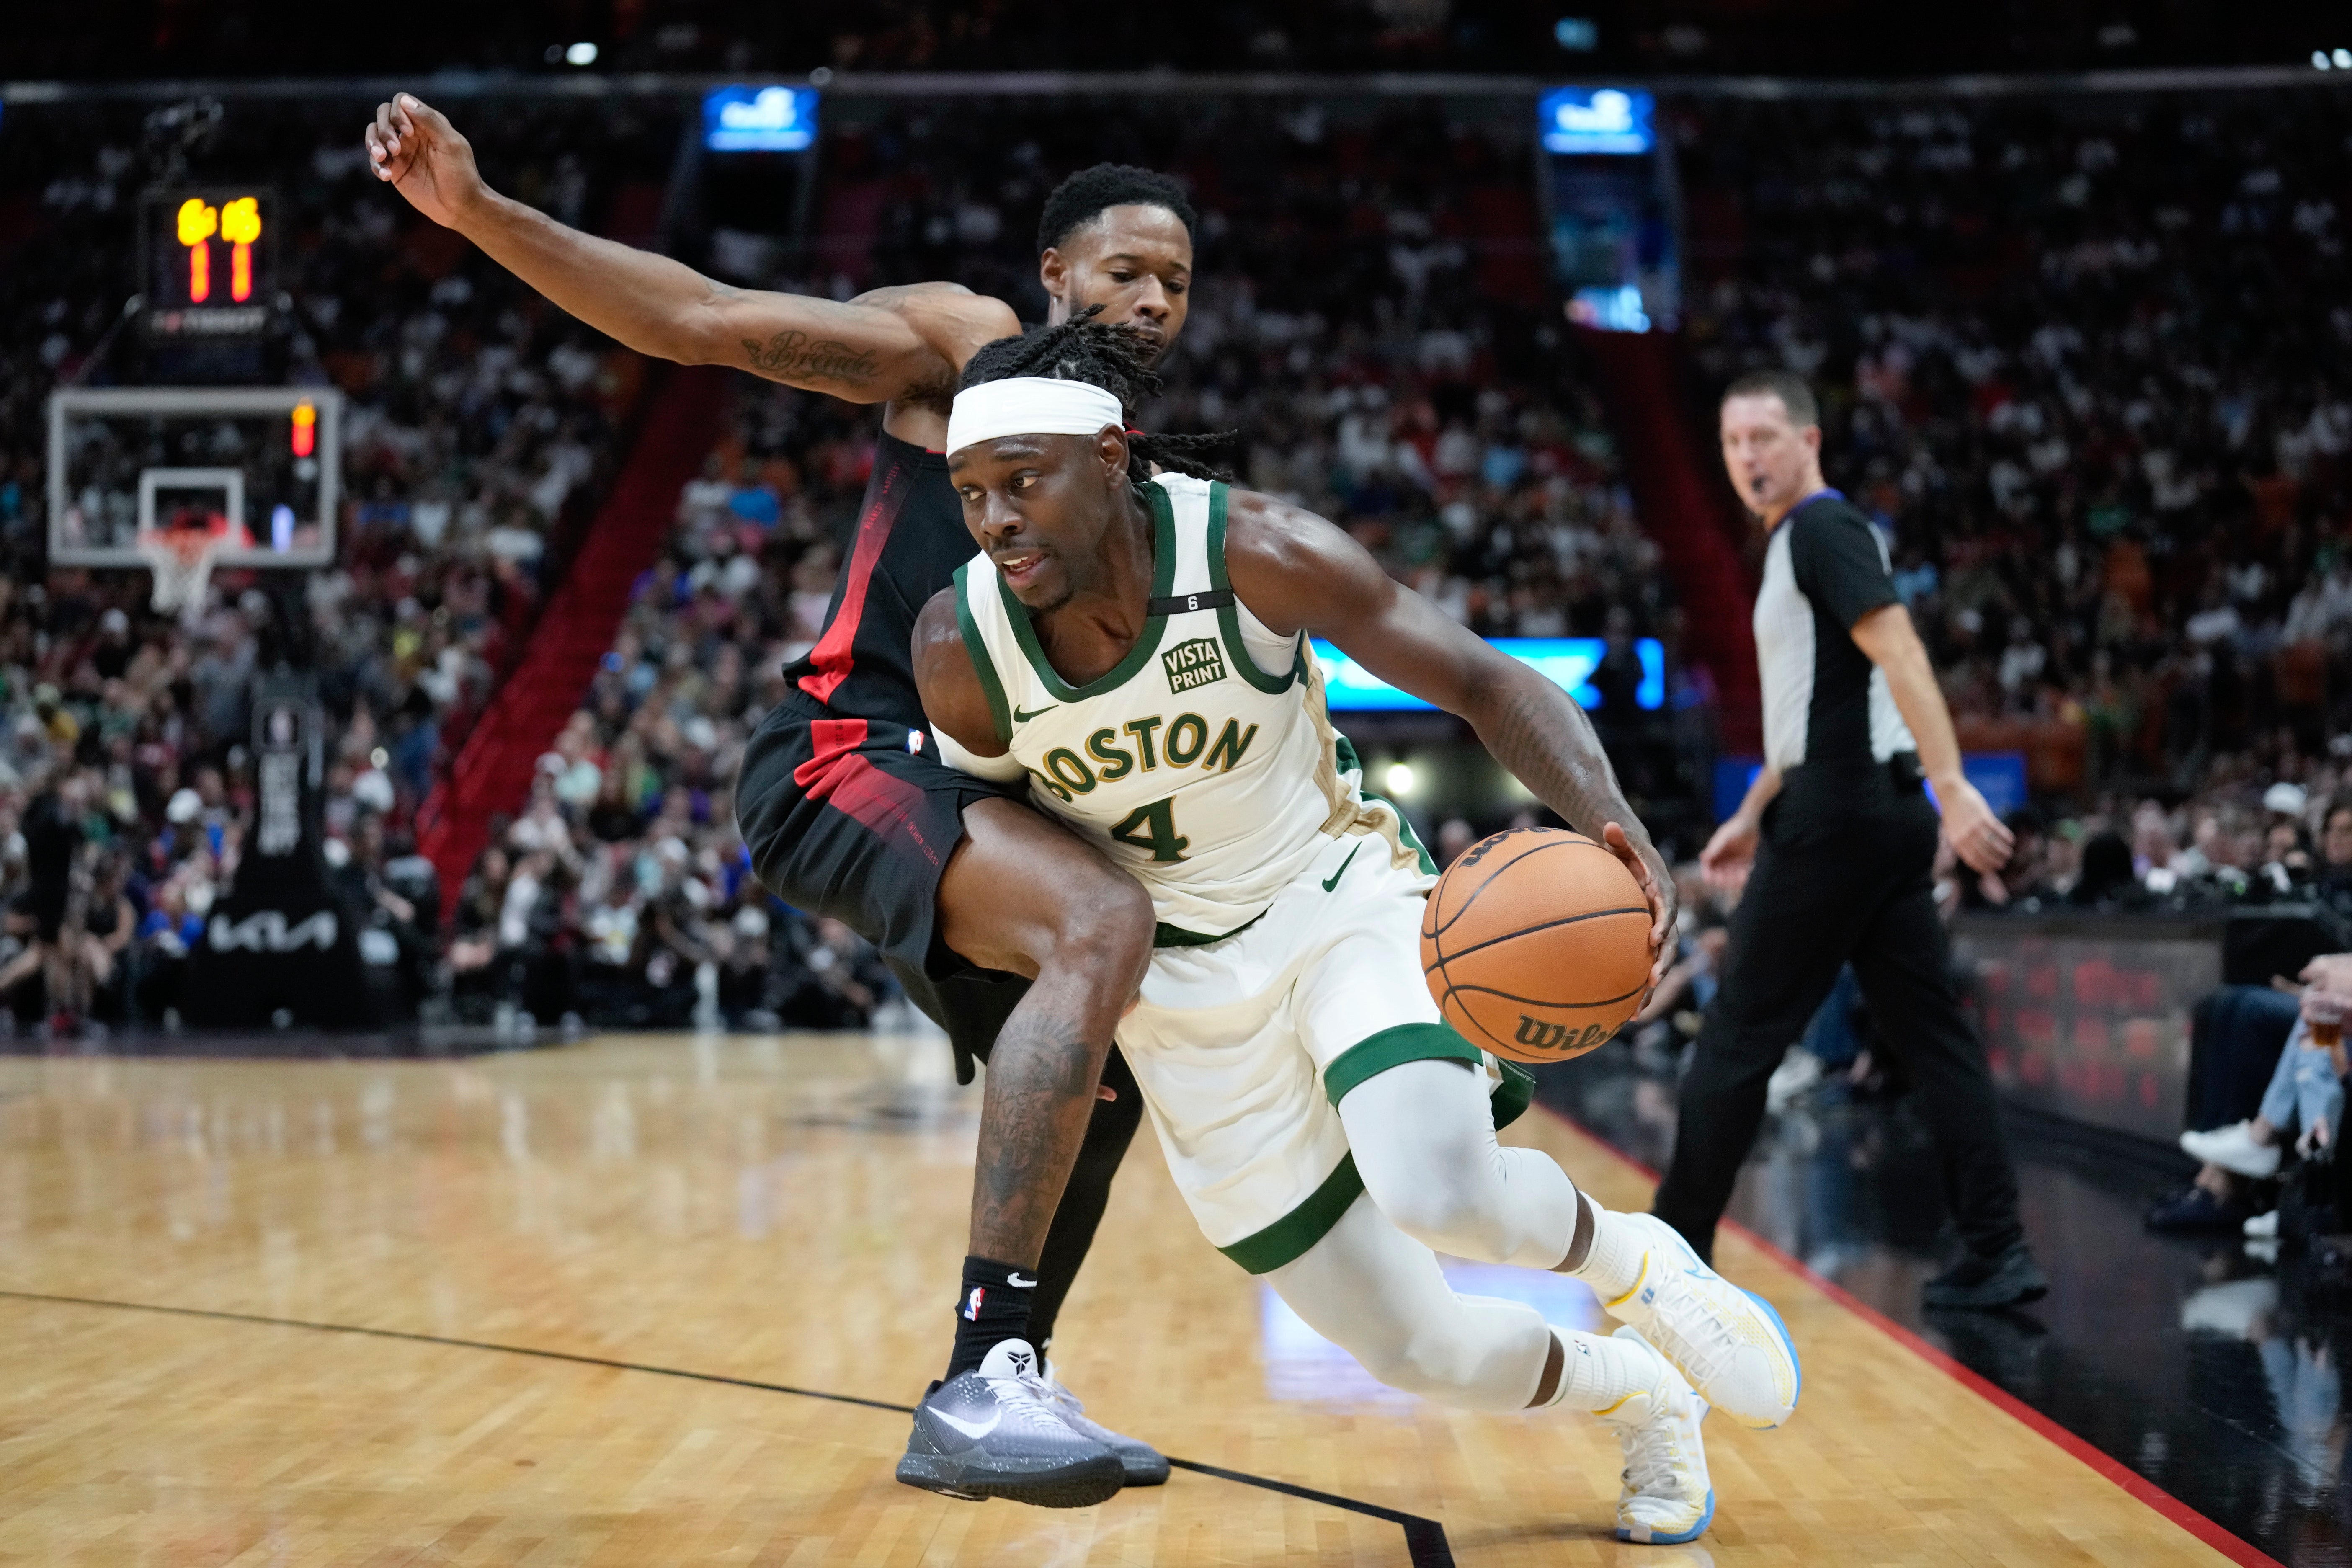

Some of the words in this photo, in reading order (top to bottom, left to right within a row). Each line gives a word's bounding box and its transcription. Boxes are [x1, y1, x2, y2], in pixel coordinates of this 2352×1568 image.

[1188, 596, 1198, 610] 6
[1165, 642, 1219, 673] VISTA
[1171, 662, 1221, 691] PRINT
[1027, 712, 1259, 803] BOSTON
[907, 821, 924, 846] WORKING
[1108, 794, 1192, 862] 4
